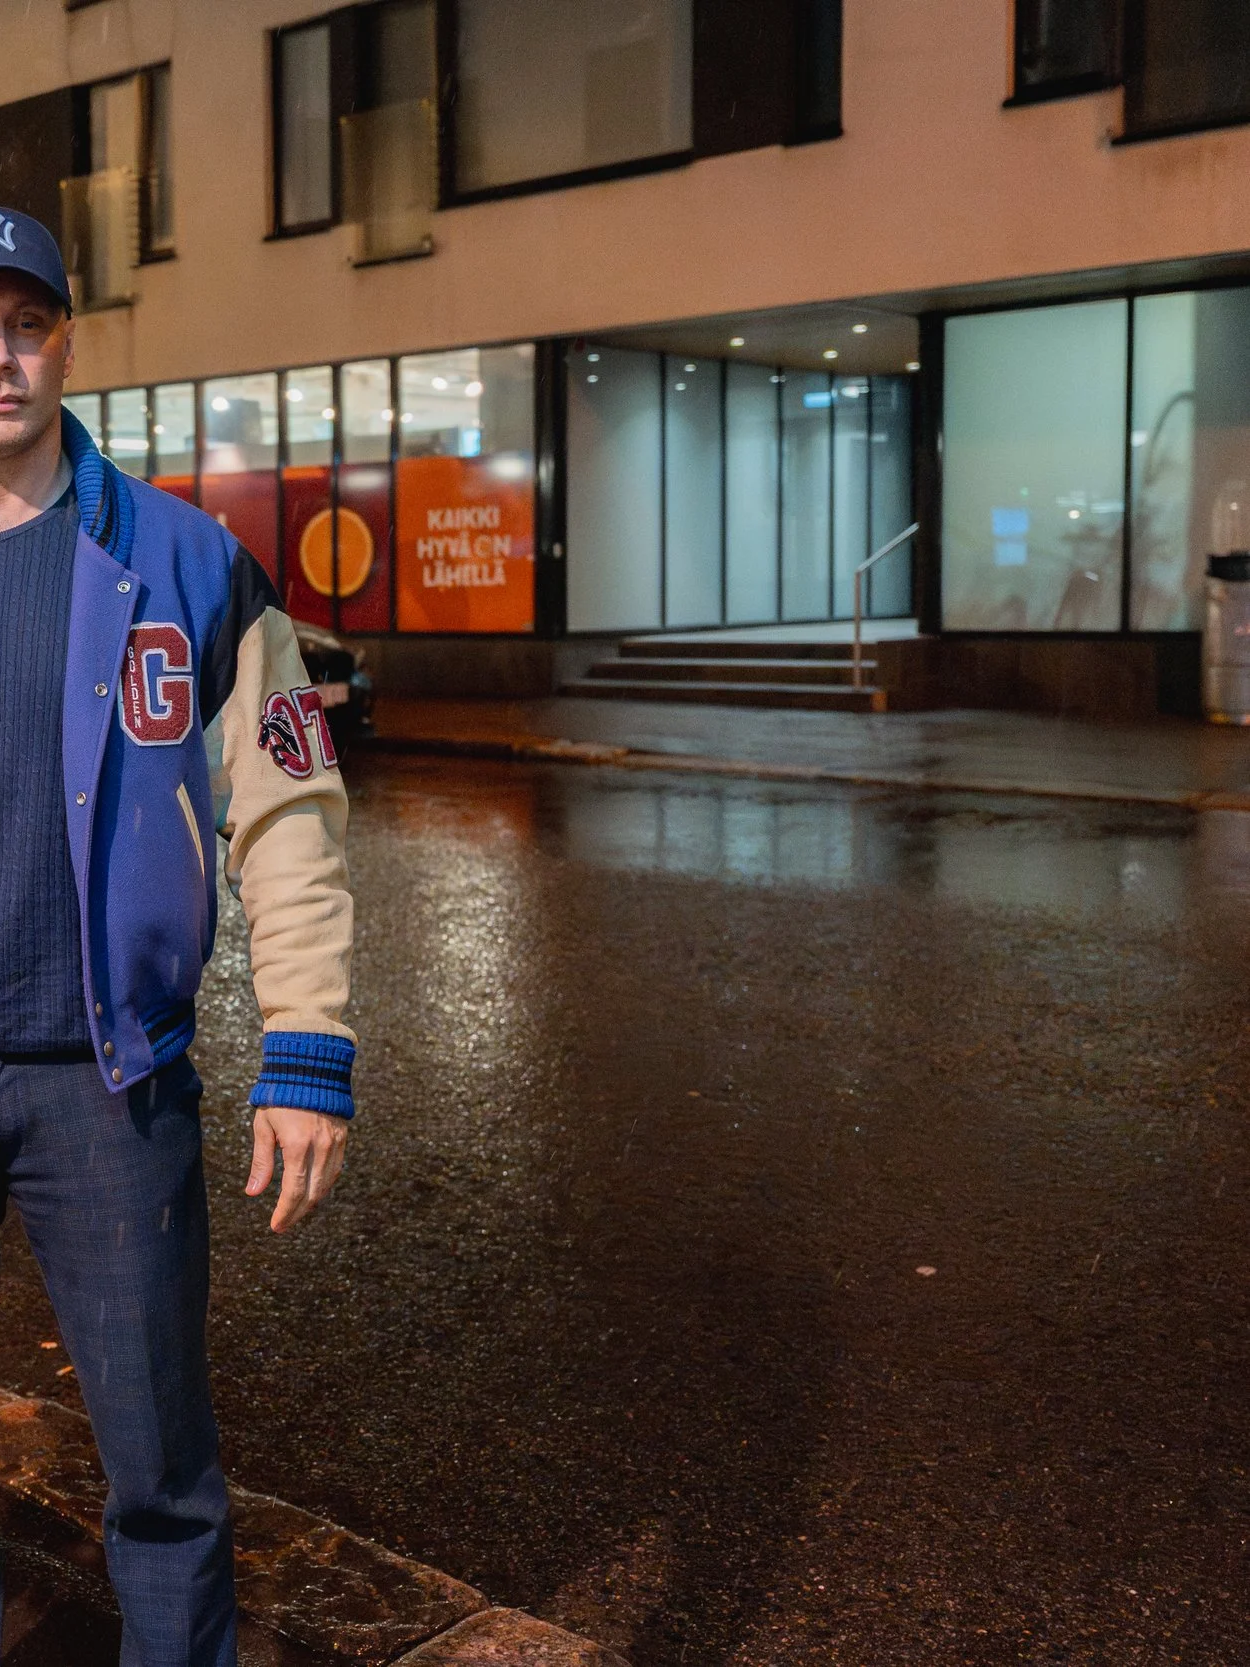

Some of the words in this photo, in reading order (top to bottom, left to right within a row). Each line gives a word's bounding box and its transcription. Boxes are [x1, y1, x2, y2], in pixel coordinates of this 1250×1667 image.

[427, 505, 500, 530] KAIKKI
[118, 621, 193, 746] G
[127, 646, 141, 728] GOLDEN
